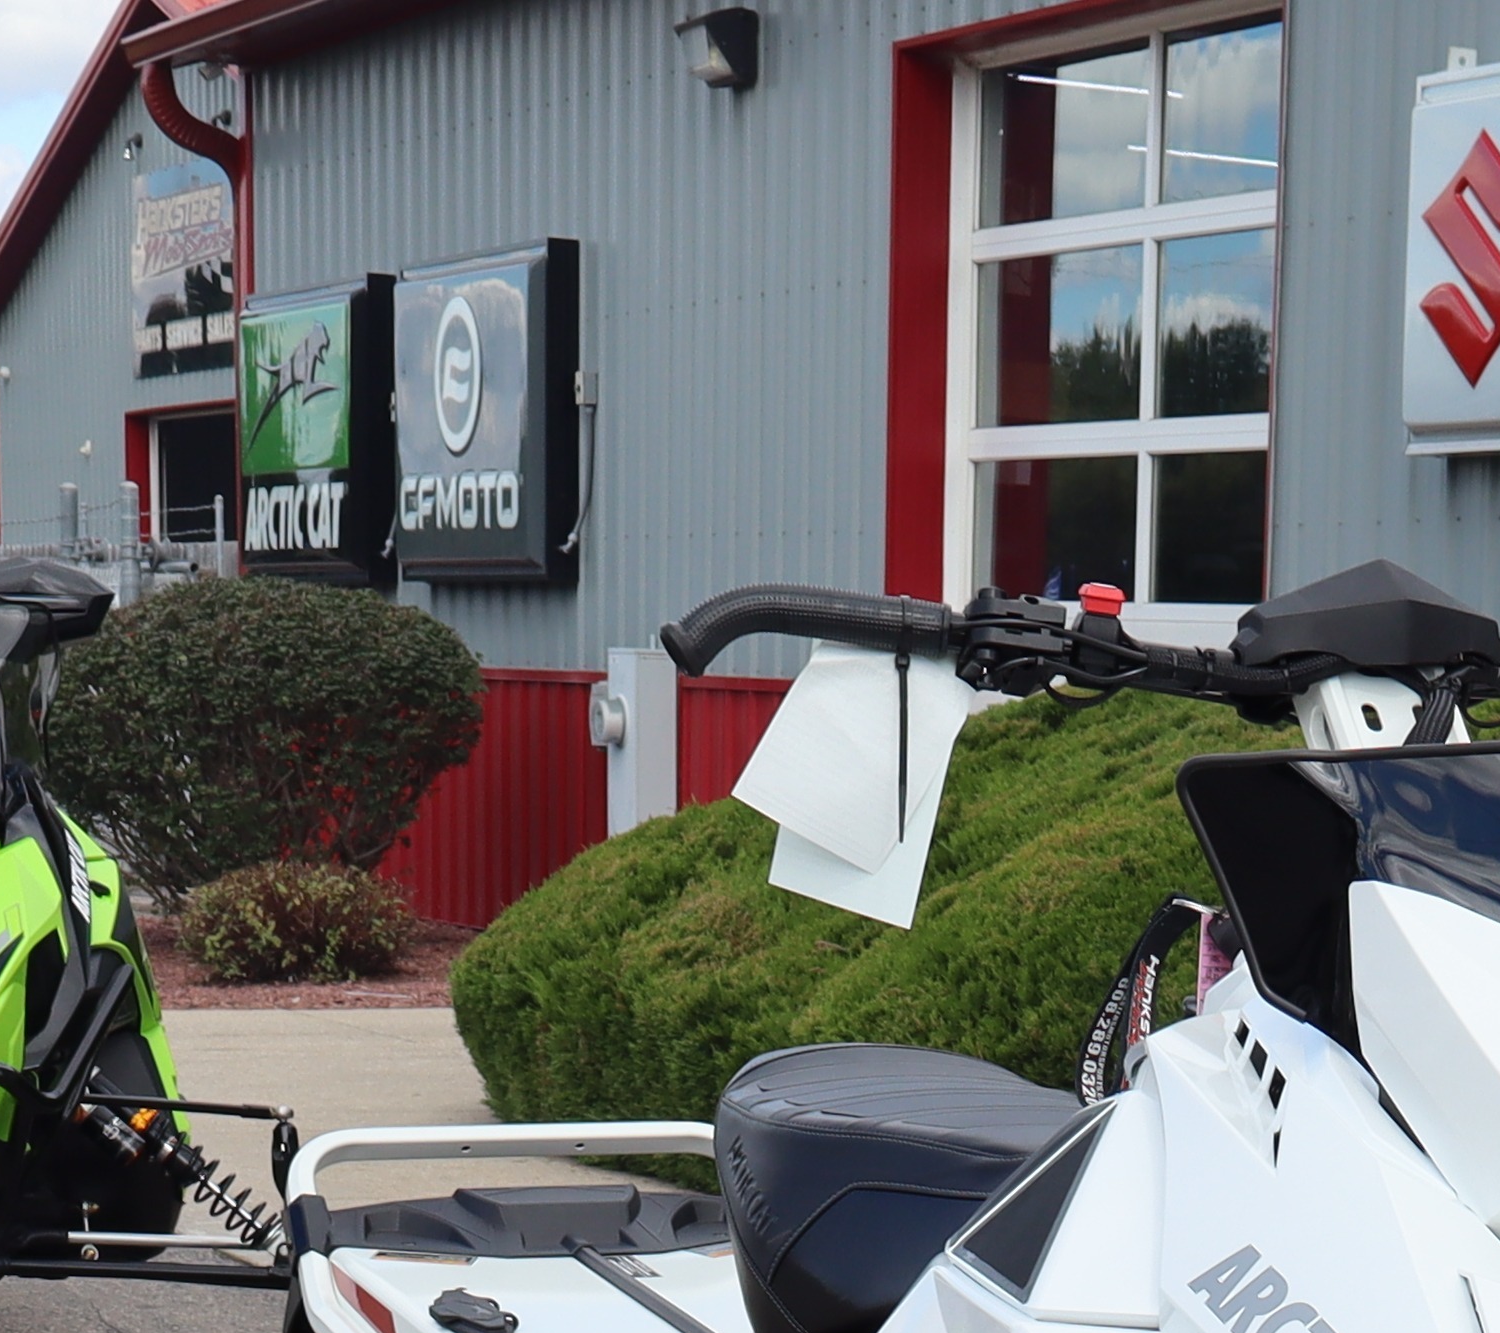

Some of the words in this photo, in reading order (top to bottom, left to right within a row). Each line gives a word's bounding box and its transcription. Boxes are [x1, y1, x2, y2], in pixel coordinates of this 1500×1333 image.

[244, 485, 304, 551] ARCTIC
[306, 482, 345, 549] CAT
[400, 469, 519, 530] CFMOTO
